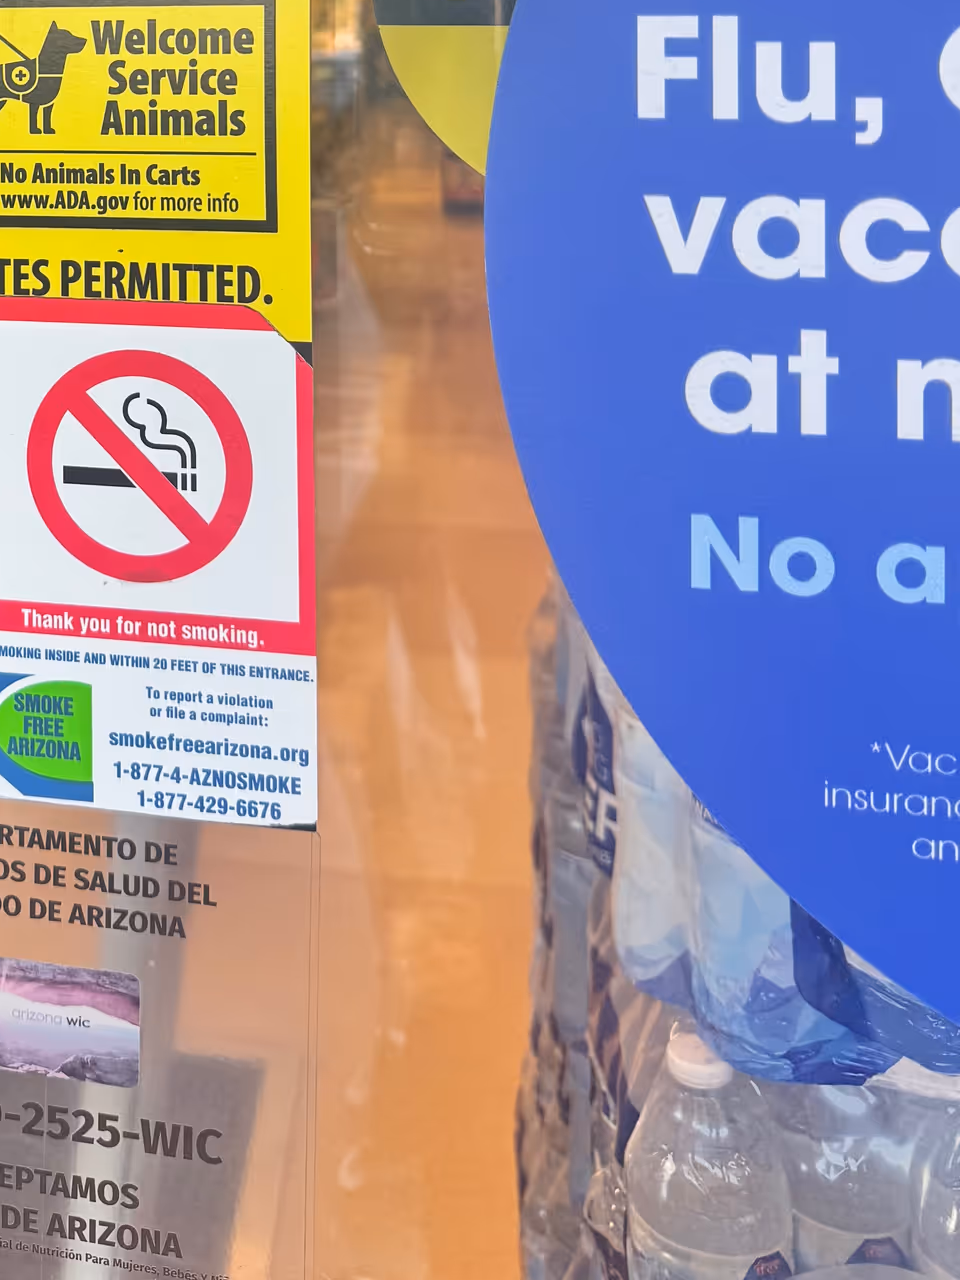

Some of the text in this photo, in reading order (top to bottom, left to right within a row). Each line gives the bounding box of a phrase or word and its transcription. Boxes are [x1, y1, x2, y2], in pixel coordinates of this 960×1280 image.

[91, 19, 254, 54] Welcome
[108, 60, 237, 95] Service
[637, 15, 883, 144] Flu,
[101, 100, 246, 136] Animals
[1, 163, 200, 185] No Animals In Carts
[1, 190, 129, 214] www.ADA.gov
[133, 191, 156, 210] for
[161, 197, 202, 211] more
[208, 193, 238, 212] info
[60, 260, 274, 305] PERMITTED.
[684, 328, 839, 435] at
[690, 513, 835, 597] No
[22, 609, 264, 648] Thank you for not smoking.
[45, 649, 80, 662] INSIDE
[84, 652, 106, 664] AND
[110, 654, 149, 668] WITHIN
[154, 658, 167, 670] 20
[171, 659, 198, 672] FEET
[202, 662, 216, 674] OF
[220, 664, 245, 676] THIS
[250, 666, 313, 682] ENTRANCE.
[14, 693, 73, 716] SMOKE
[146, 686, 273, 709] To report a violation
[24, 716, 64, 737] FREE
[150, 706, 268, 726] or file a complaint:
[6, 737, 81, 761] ARIZONA
[109, 732, 308, 767] smokefreearizona.org
[114, 761, 301, 795] 1-877-4-AZNOSMOKE
[137, 790, 281, 820] 1-877-429-6676
[145, 841, 178, 866] DE
[34, 863, 66, 887] DE
[74, 868, 160, 898] SALUD
[168, 880, 217, 906] DEL
[30, 898, 61, 922] DE
[68, 904, 186, 938] ARIZONA
